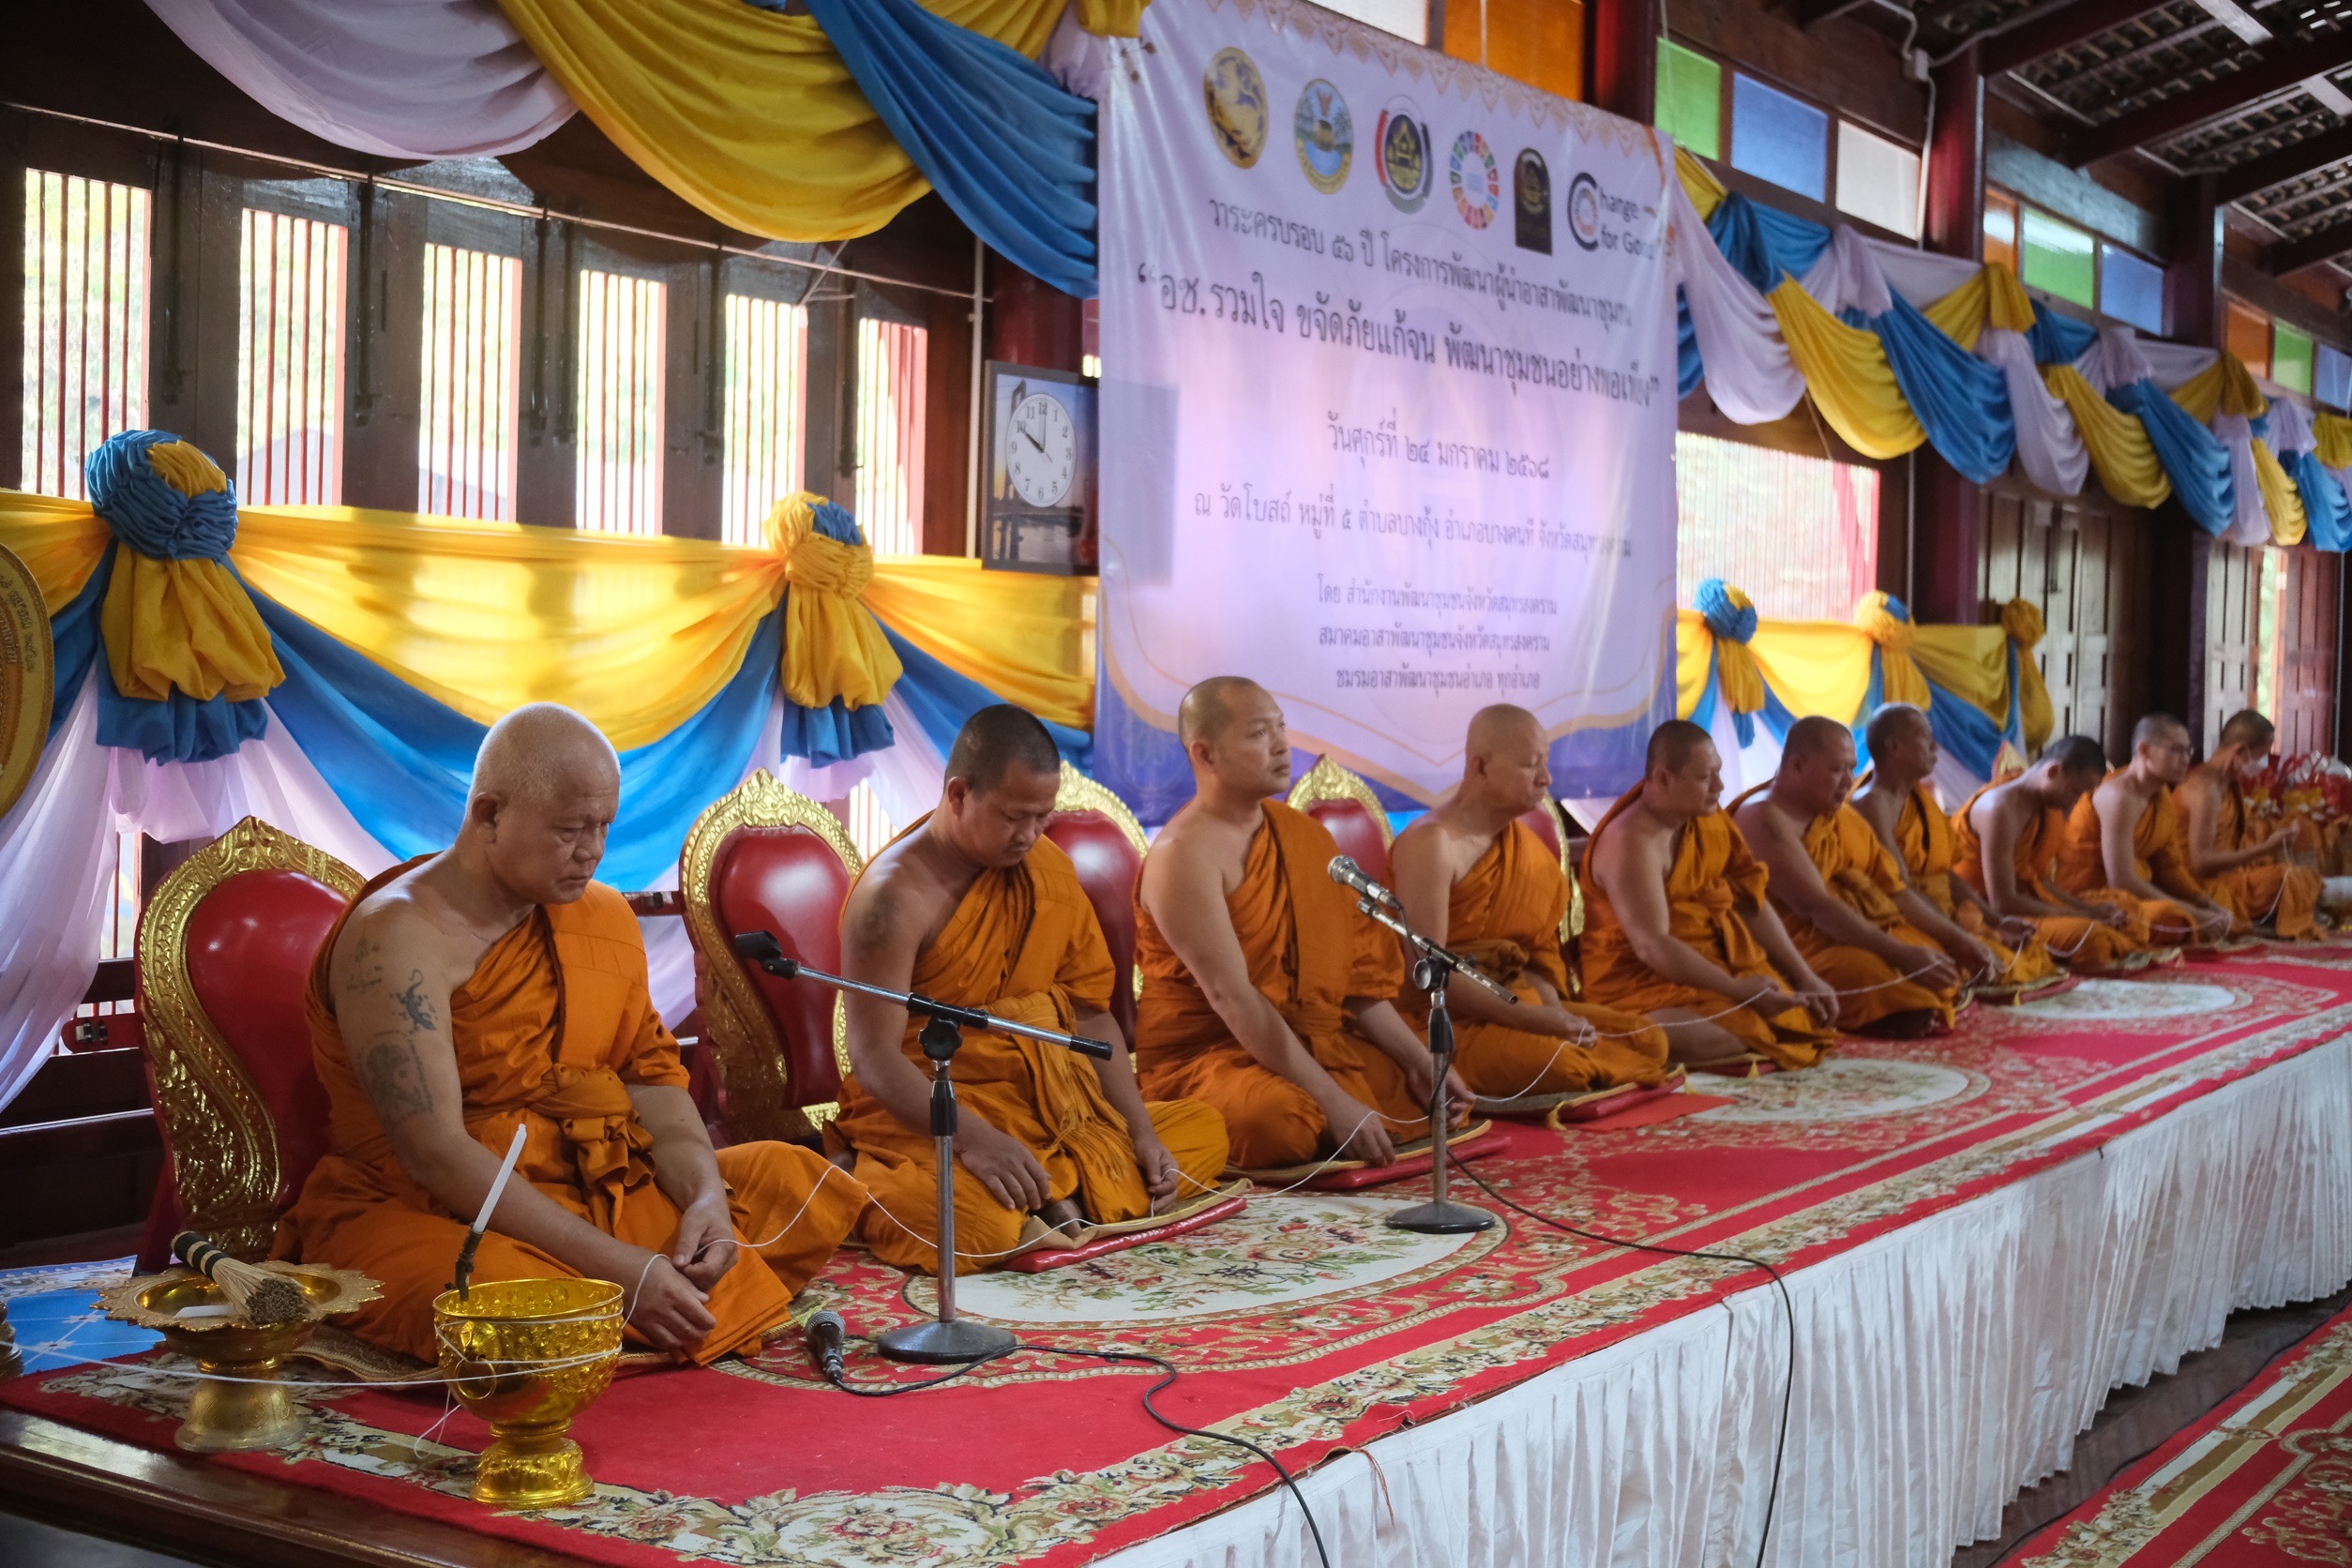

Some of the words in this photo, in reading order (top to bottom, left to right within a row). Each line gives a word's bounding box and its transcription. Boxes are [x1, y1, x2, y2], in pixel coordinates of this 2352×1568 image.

[1210, 200, 1324, 254] วาระครบรอบ
[1361, 228, 1374, 268] ปี
[1380, 231, 1632, 334] โครงการพัฒนาผู้นำอาสาพัฒนาชุม
[1297, 291, 1436, 364] ขจัดภัยแก้จน
[1026, 405, 1035, 420] 11
[1038, 401, 1048, 415] 12
[1063, 426, 1069, 439] 2
[1328, 407, 1398, 468] วันศุกร์ที่
[1405, 435, 1429, 464] ๒๔
[1437, 441, 1500, 473] มกราคม
[1011, 441, 1018, 454] 9
[1065, 446, 1072, 460] 3
[1015, 462, 1021, 475] 8
[1062, 466, 1068, 479] 4
[1025, 478, 1031, 491] 7
[1051, 481, 1058, 494] 5
[1038, 487, 1045, 500] 6
[1195, 492, 1211, 516] ณ
[1220, 483, 1291, 523] วัดโบสถ์
[1299, 483, 1335, 540] หมู่ที่
[1359, 499, 1440, 550] ตำบลบางกุ้ง
[1317, 573, 1341, 604] โดย
